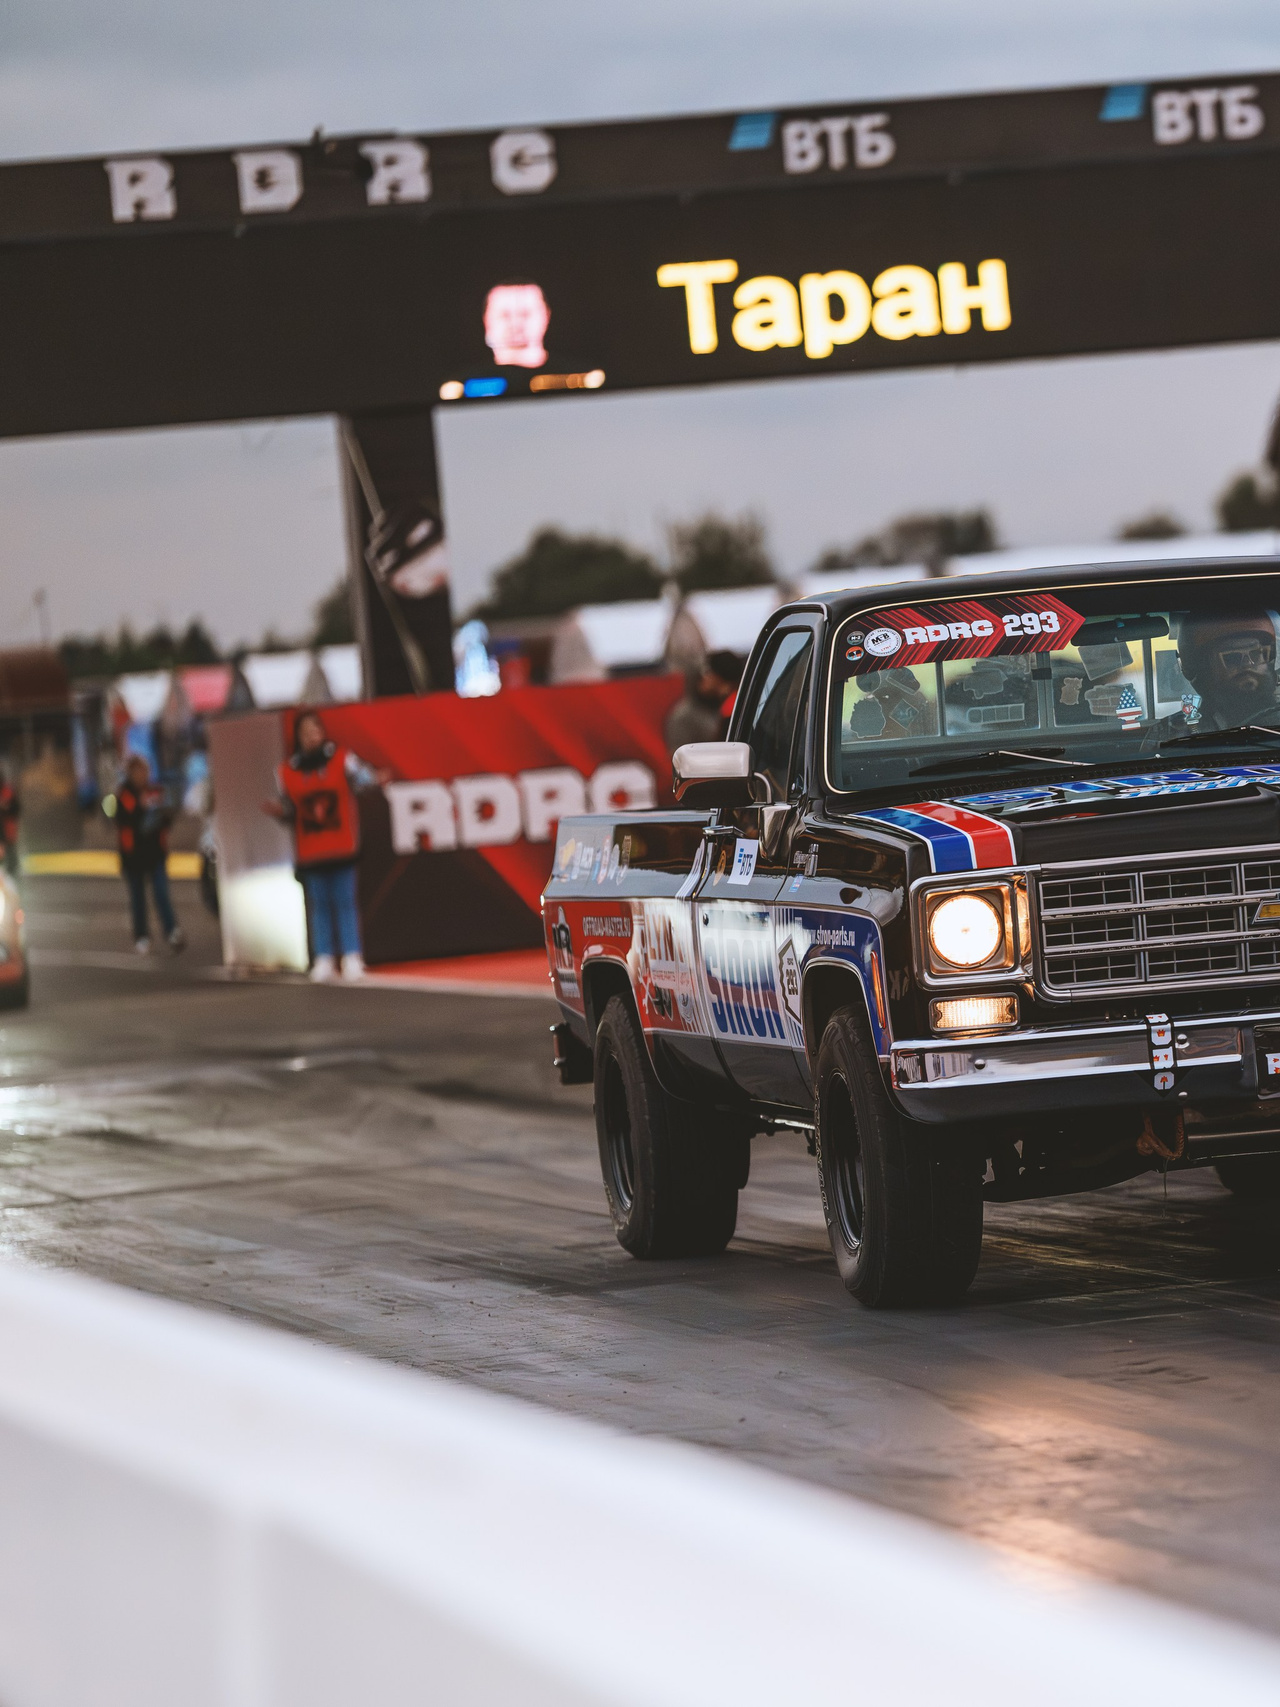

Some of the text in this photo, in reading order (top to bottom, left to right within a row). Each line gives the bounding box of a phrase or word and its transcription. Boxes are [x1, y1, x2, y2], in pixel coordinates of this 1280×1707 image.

[782, 112, 896, 174] ВТБ
[1152, 85, 1264, 145] ВТБ
[656, 257, 1012, 361] Таран
[902, 619, 994, 646] RDRC
[1001, 611, 1061, 638] 293
